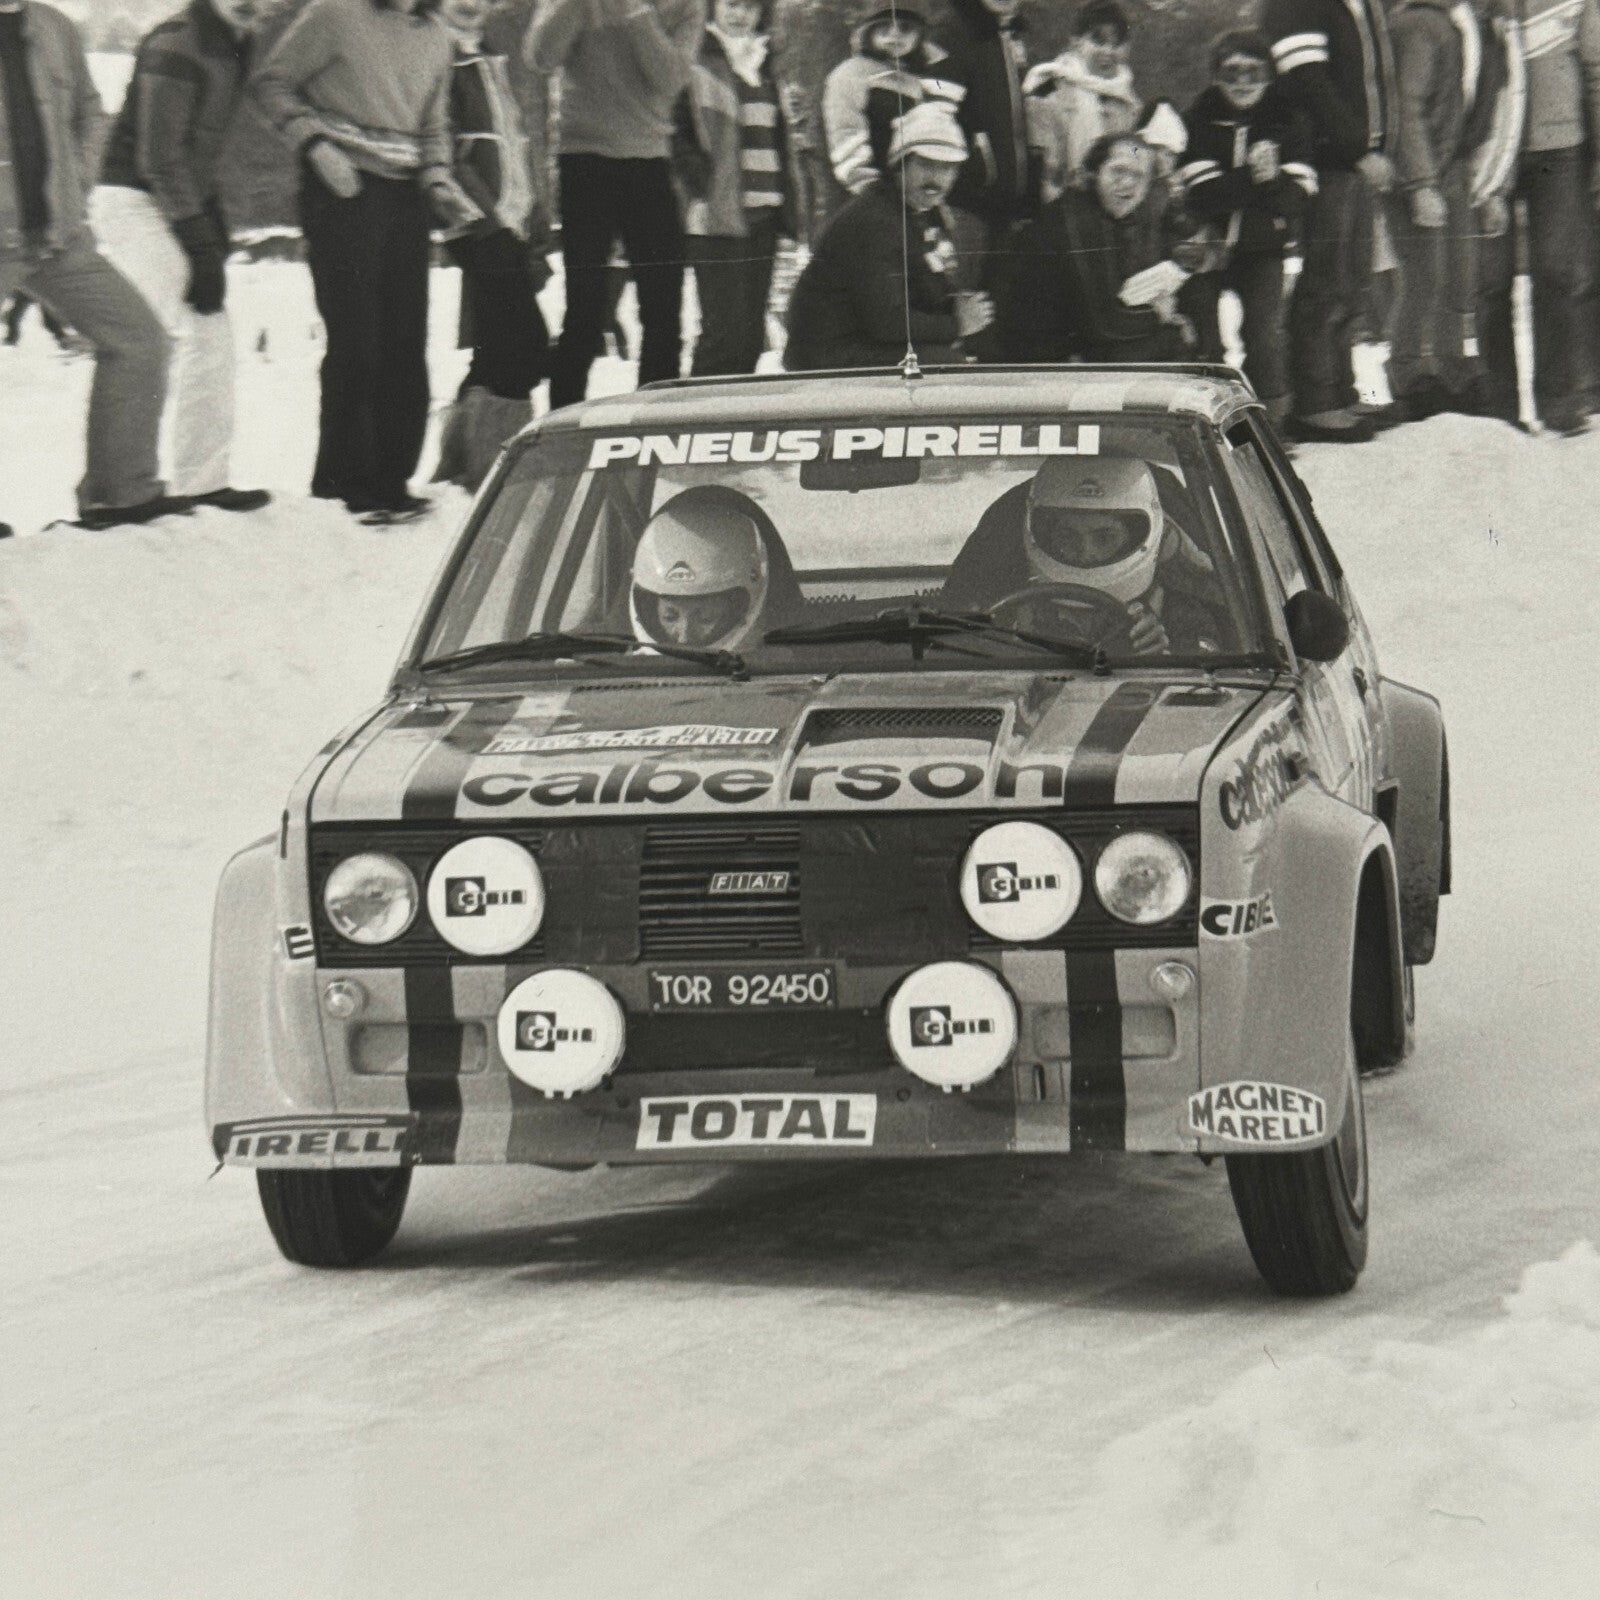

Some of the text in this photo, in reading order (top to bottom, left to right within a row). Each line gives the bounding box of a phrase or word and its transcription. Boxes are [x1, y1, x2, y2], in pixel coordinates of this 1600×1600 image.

[587, 425, 1100, 469] PNEUS PIRELLI
[462, 762, 1064, 806] calberson
[713, 873, 787, 891] FIAT
[656, 973, 829, 1005] TOR 92450
[648, 1098, 867, 1143] TOTAL
[1191, 1084, 1323, 1133] MAGNETI
